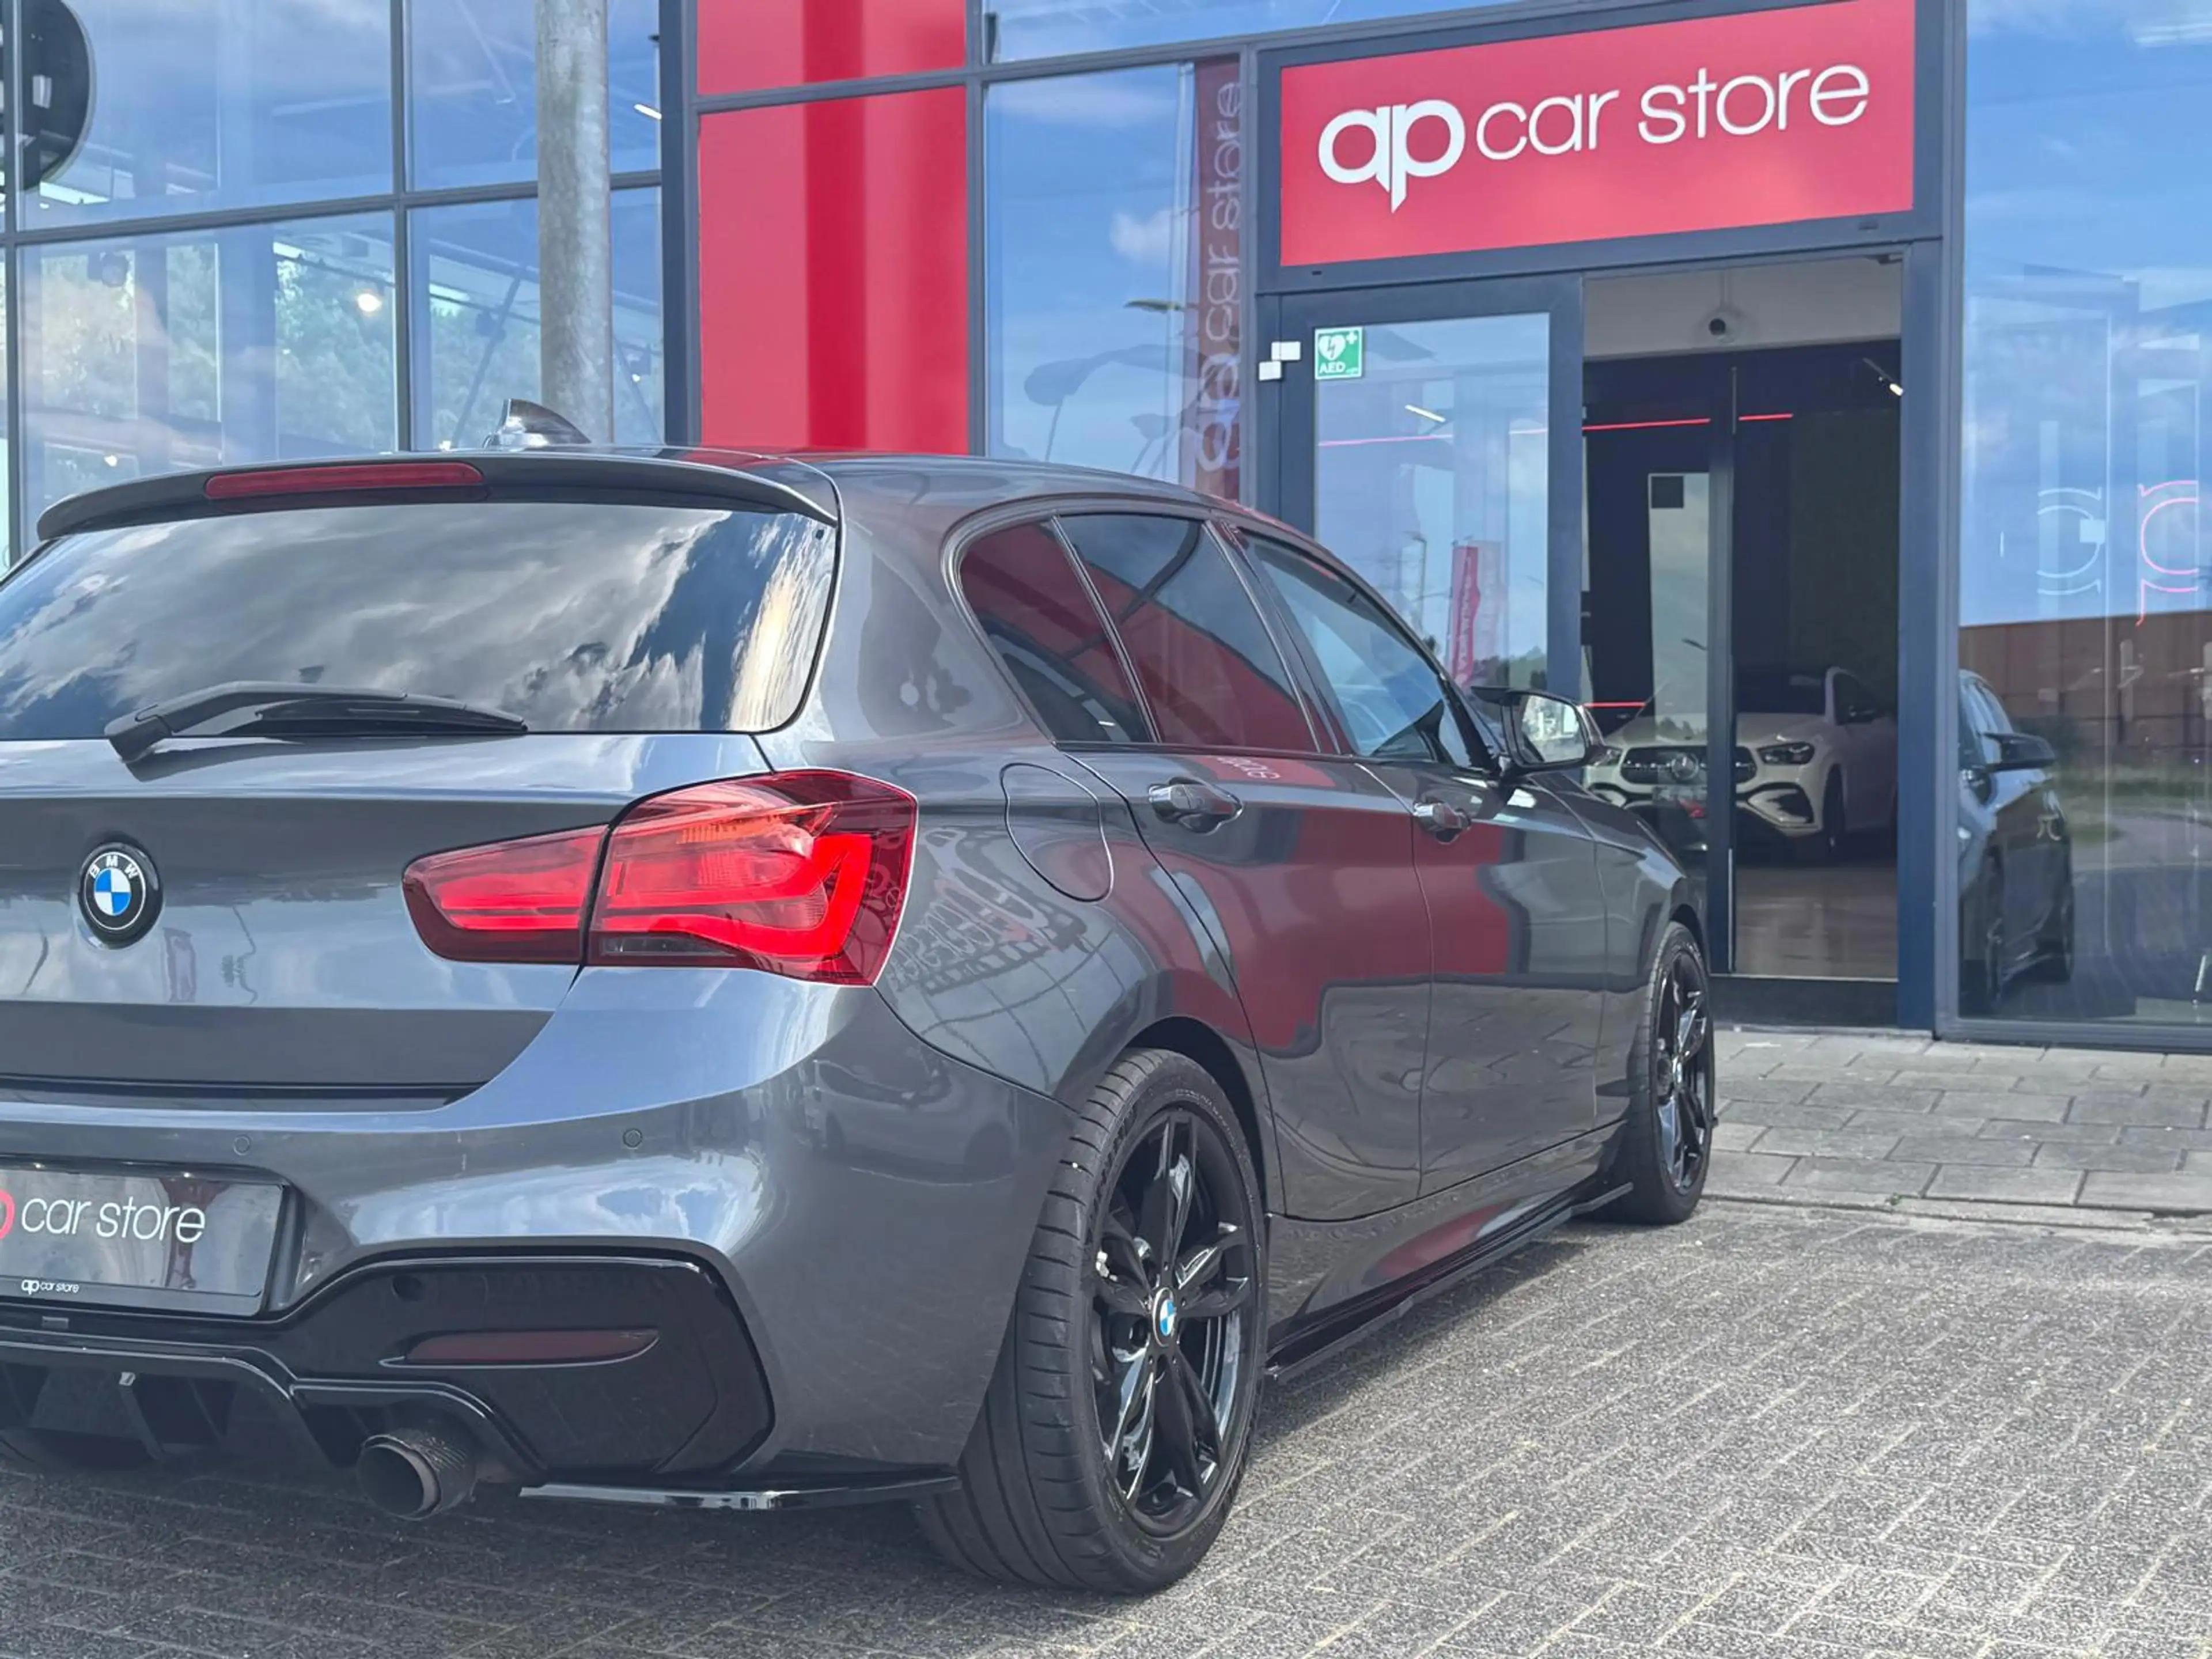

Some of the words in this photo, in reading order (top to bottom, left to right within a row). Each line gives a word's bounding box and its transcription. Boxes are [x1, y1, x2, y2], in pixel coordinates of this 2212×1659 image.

[1207, 82, 1240, 230] store
[1317, 99, 1466, 213] ap
[1476, 89, 1620, 161] car
[1638, 63, 1870, 144] store
[1319, 361, 1346, 374] AED
[89, 855, 139, 880] BMW
[21, 1197, 92, 1234] car
[96, 1195, 206, 1243] store
[21, 1279, 40, 1295] ap
[40, 1282, 56, 1291] car
[56, 1283, 79, 1294] store
